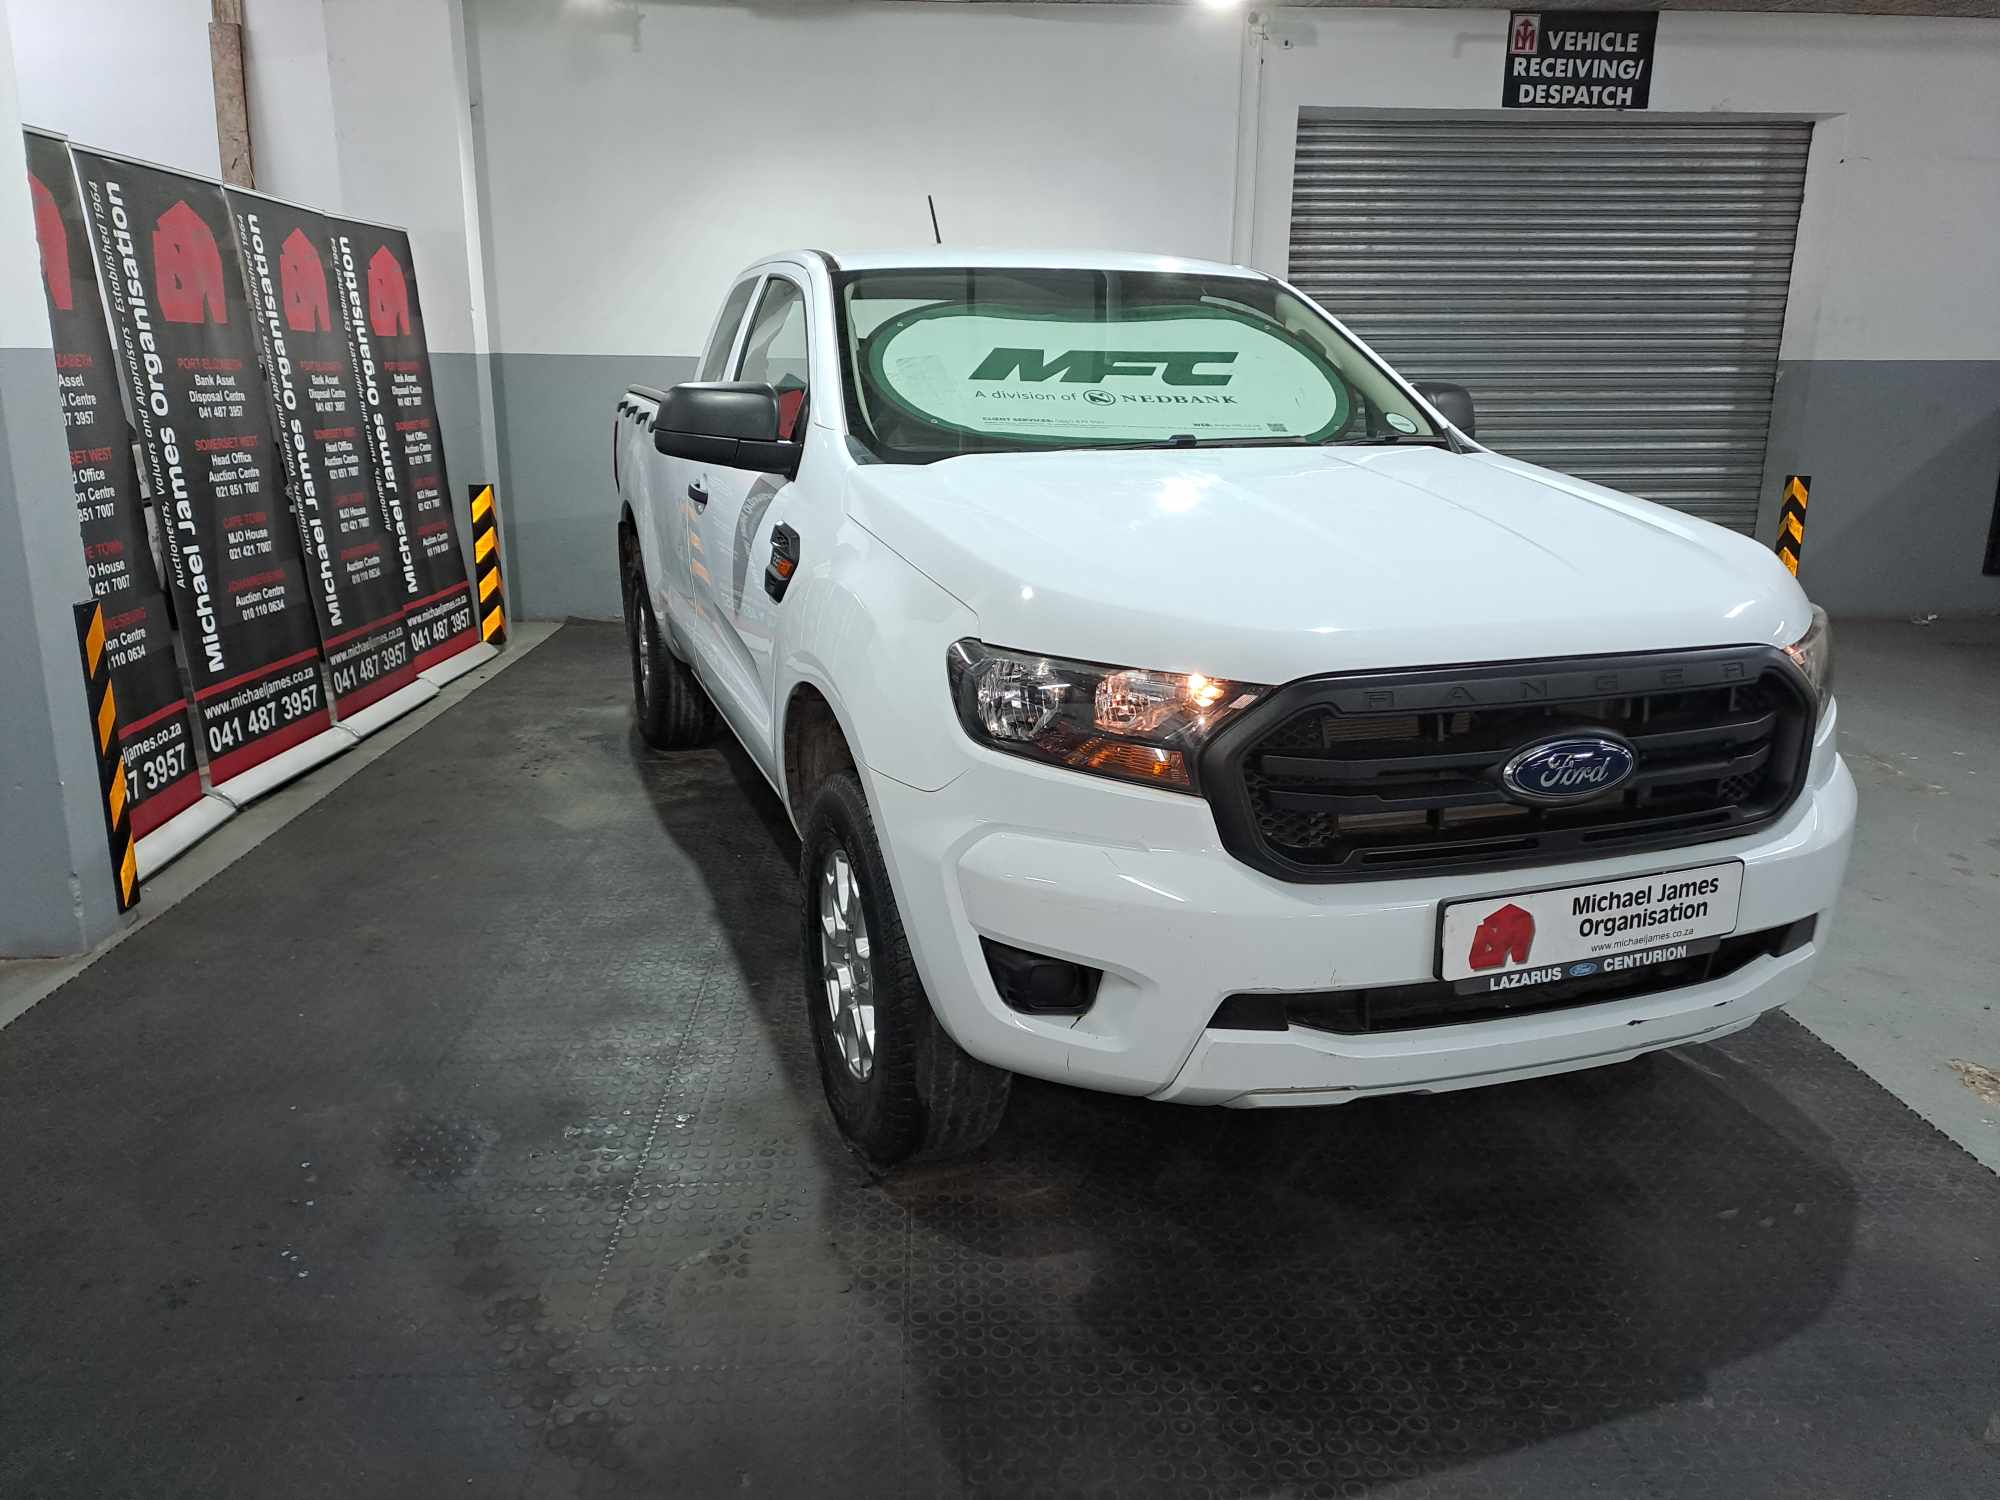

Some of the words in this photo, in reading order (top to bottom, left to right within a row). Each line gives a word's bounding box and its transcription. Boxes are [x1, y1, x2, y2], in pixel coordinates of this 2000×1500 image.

[1548, 31, 1640, 53] VEHICLE
[1513, 57, 1645, 81] RECEIVING/
[1518, 84, 1633, 106] DESPATCH
[88, 180, 105, 219] 1964
[95, 223, 126, 313] Established
[105, 181, 169, 417] Organisation
[247, 213, 297, 411] Organisation
[339, 236, 380, 406] Organisation
[122, 326, 147, 406] Appraisers
[194, 373, 215, 386] Bank
[216, 374, 236, 386] Asset
[968, 347, 1239, 386] MFC
[58, 373, 85, 387] Asset
[68, 392, 97, 406] Centre
[188, 390, 223, 405] Disposal
[975, 390, 986, 399] A
[991, 390, 1056, 401] division
[1061, 391, 1078, 401] of
[1121, 394, 1238, 404] NEDBANK
[74, 411, 94, 425] 3957
[138, 409, 153, 438] and
[198, 406, 213, 418] 041
[213, 406, 227, 418] 487
[211, 454, 231, 466] Head
[231, 452, 253, 464] Office
[290, 419, 319, 511] James
[373, 413, 398, 493] James
[79, 467, 105, 483] Office
[148, 442, 166, 495] Valuers
[160, 427, 197, 536] James
[208, 470, 237, 483] Auction
[238, 467, 260, 479] Centre
[87, 486, 115, 501] Centre
[215, 485, 228, 498] 021
[229, 483, 243, 496] 851
[95, 503, 115, 518] 7007
[228, 531, 244, 544] MJO
[245, 528, 269, 540] House
[389, 499, 418, 594] Michael
[229, 547, 242, 560] 021
[242, 544, 256, 557] 421
[97, 560, 126, 577] House
[309, 518, 343, 627] Michael
[94, 580, 110, 596] 421
[112, 574, 131, 592] 7007
[235, 592, 262, 607] Auction
[262, 585, 286, 599] Centre
[182, 545, 225, 673] Michael
[255, 604, 268, 617] 110
[268, 599, 286, 613] 0634
[120, 627, 146, 645] Centre
[411, 626, 431, 652] 041
[432, 618, 449, 641] 487
[450, 608, 470, 633] 3957
[110, 651, 127, 668] 110
[127, 643, 146, 662] 0634
[333, 664, 358, 694] 041
[360, 654, 380, 681] 487
[381, 641, 407, 671] 3957
[204, 667, 314, 720] www.michaeljames.co.za
[1363, 660, 1746, 709] RANGER
[208, 717, 243, 753] 041
[248, 701, 276, 734] 487
[281, 684, 318, 720] 3957
[143, 742, 185, 790] 3957
[1538, 750, 1611, 790] Ford
[1572, 885, 1652, 916] Michael
[1657, 876, 1720, 903] James
[1579, 900, 1708, 938] Organisation
[1591, 928, 1694, 953] www.michaeljames.co.za
[1490, 967, 1562, 992] LAZARUS
[1603, 945, 1687, 972] CENTURION
